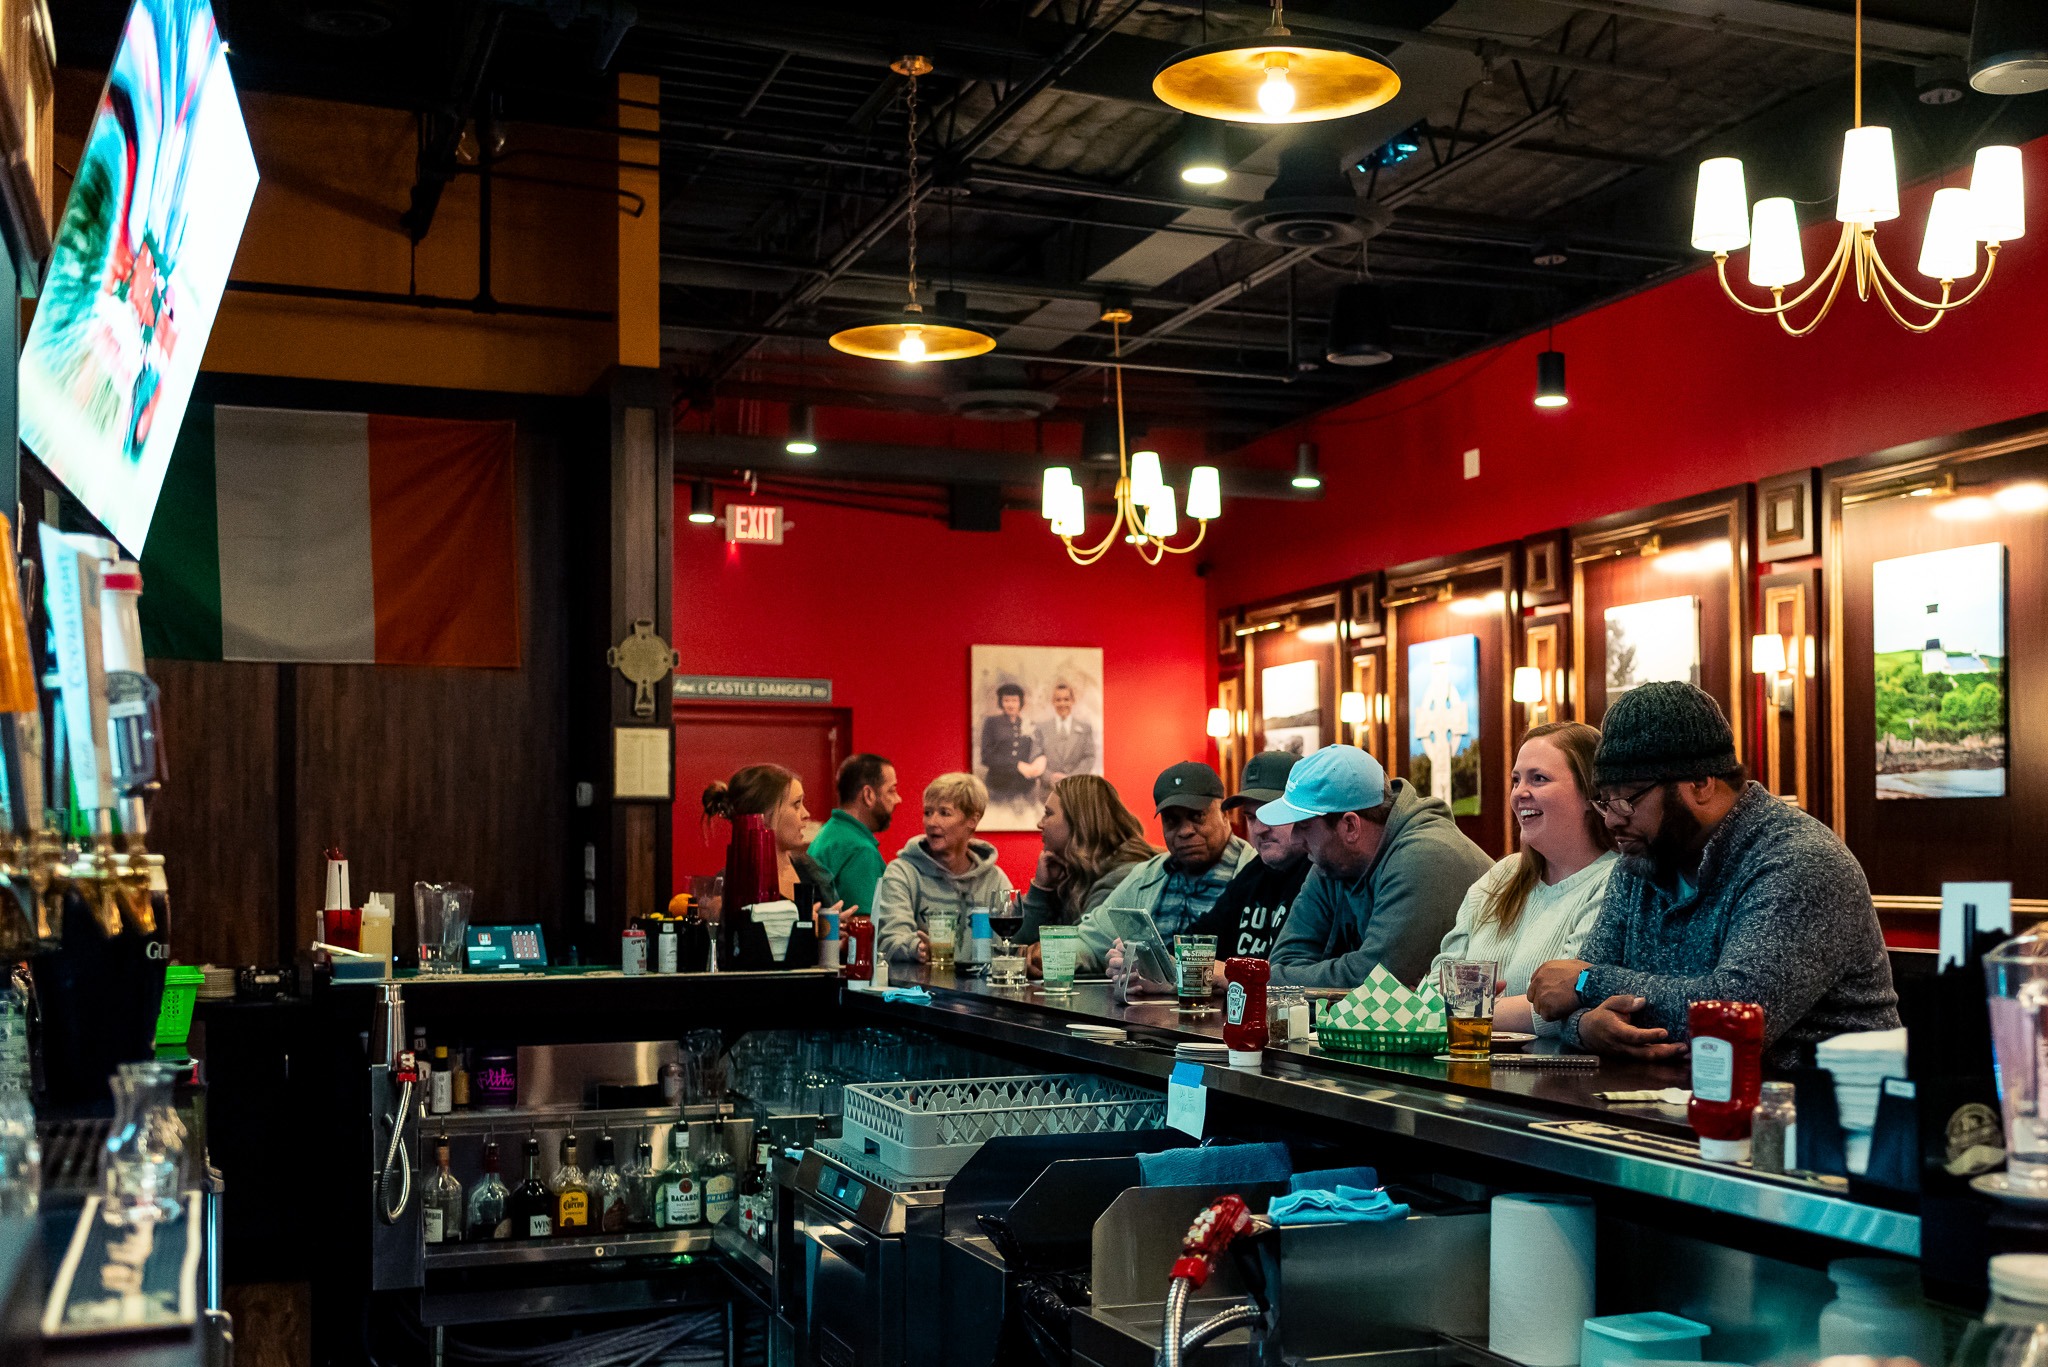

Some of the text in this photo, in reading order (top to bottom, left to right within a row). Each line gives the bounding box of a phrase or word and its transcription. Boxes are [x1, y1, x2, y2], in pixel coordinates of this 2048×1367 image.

[735, 506, 776, 540] EXIT
[706, 681, 756, 696] CASTLE
[757, 683, 812, 697] DANGER
[477, 1067, 515, 1090] Filthy
